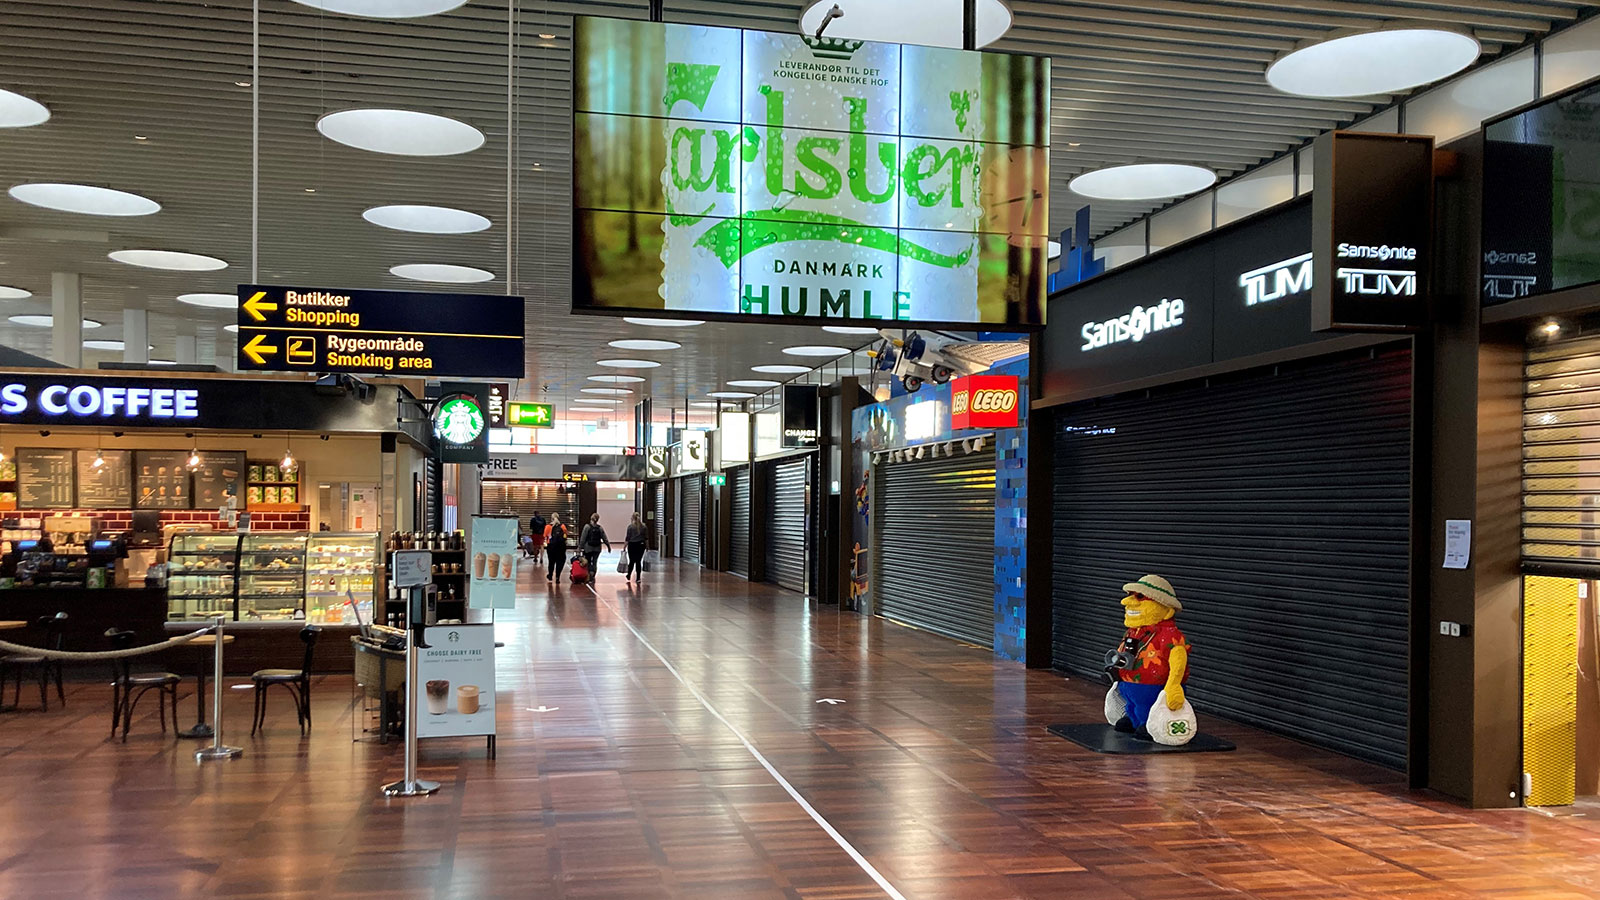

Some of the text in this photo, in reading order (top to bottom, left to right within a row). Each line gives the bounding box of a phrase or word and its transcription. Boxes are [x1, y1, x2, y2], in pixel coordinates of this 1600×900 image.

[773, 70, 827, 81] KONGELIGE
[831, 75, 867, 84] DANSKE
[780, 60, 880, 77] LEVERANDØR TIL DET
[1337, 243, 1416, 260] Samsonite
[774, 259, 883, 278] DANMARK
[1239, 252, 1313, 306] TUM
[1337, 267, 1416, 296] TUMI
[286, 291, 350, 306] Butikker
[742, 284, 911, 321] HUMLE
[286, 308, 360, 326] Shopping
[1080, 298, 1184, 351] Samsonite
[327, 335, 424, 352] Rygeområde
[327, 352, 433, 370] Smoking area
[38, 384, 199, 418] COFFEE
[953, 391, 968, 414] LEGO
[973, 390, 1016, 412] LEGO
[785, 429, 816, 437] CHANGE
[487, 458, 517, 470] FREE
[649, 453, 665, 477] S
